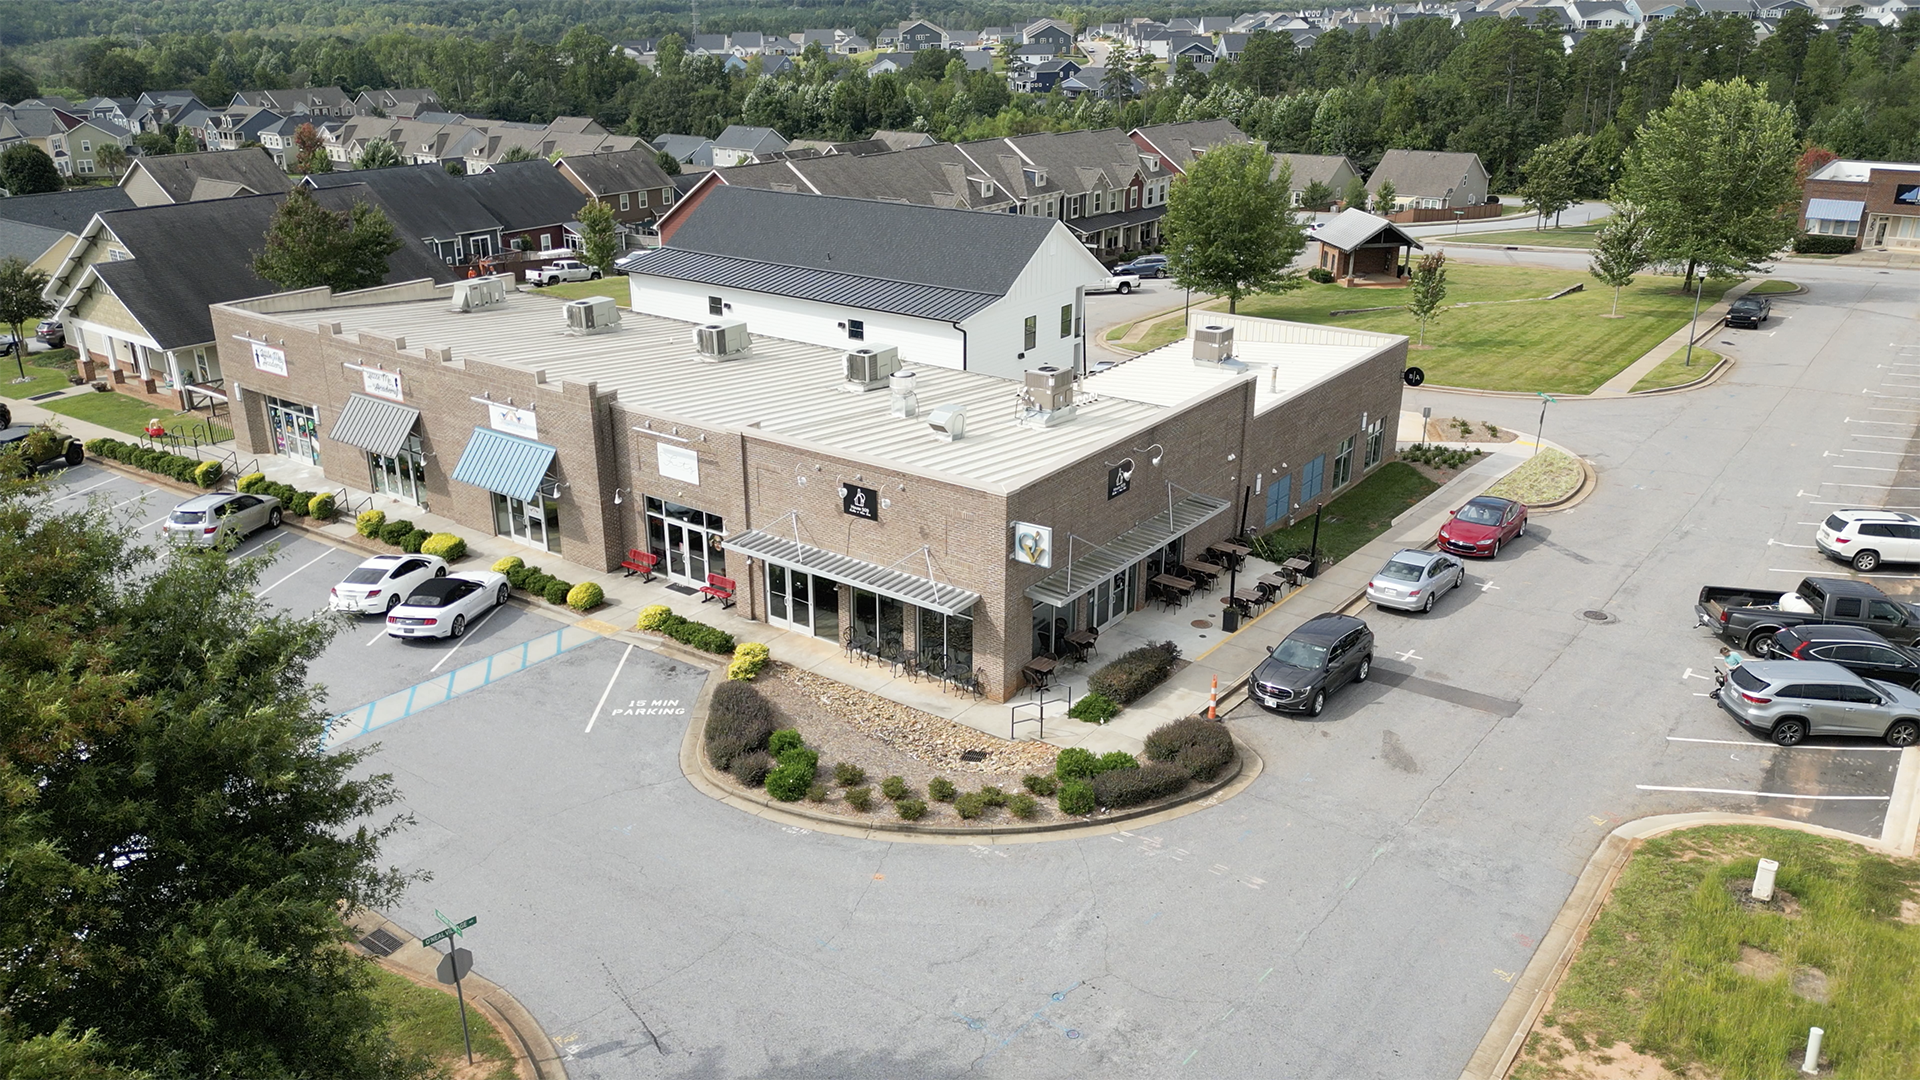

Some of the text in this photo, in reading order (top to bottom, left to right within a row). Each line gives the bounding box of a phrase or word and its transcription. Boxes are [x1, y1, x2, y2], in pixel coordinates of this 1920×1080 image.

[651, 699, 679, 707] MIN
[611, 708, 685, 716] PARKING
[425, 932, 445, 945] O'NEAL
[445, 921, 468, 936] VILGE
